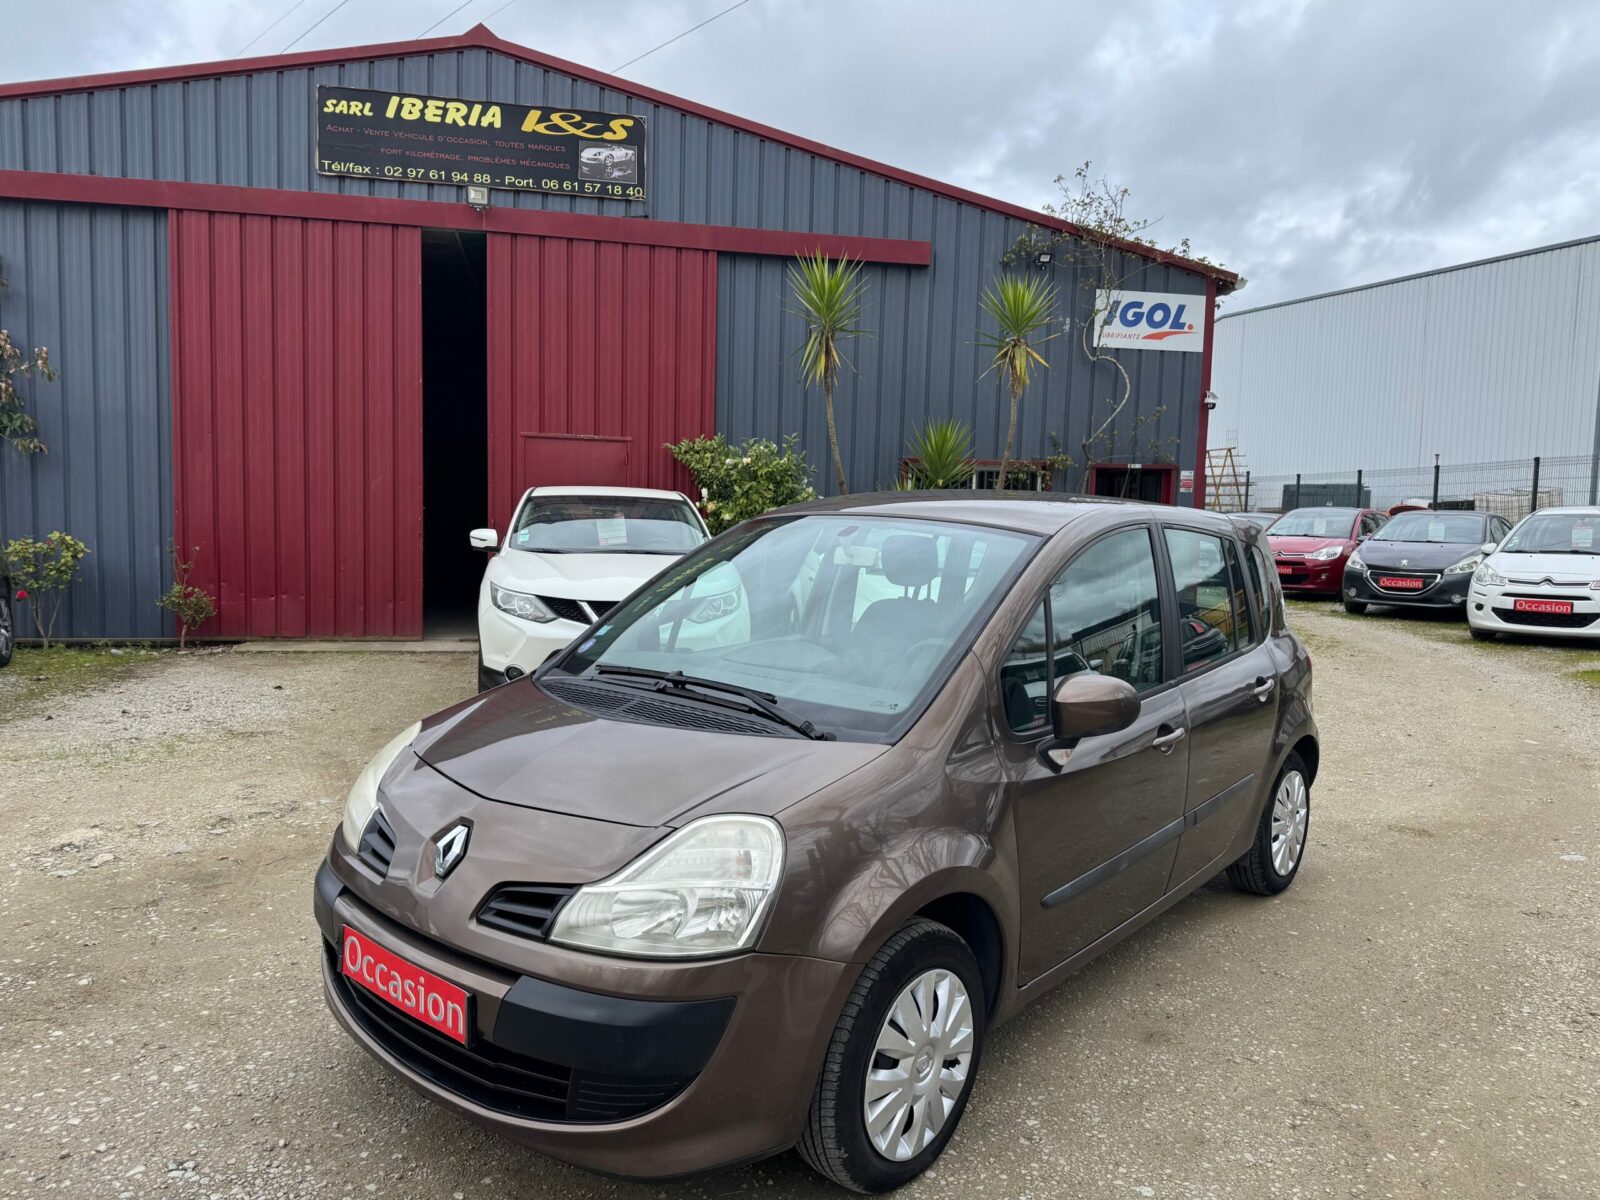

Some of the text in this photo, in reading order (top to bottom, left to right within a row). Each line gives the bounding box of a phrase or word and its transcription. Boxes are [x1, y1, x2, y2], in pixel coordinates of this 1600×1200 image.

[323, 99, 374, 117] SARL
[385, 96, 502, 129] IBERIA
[326, 124, 354, 133] ACHAT
[363, 128, 390, 137] VENTE
[494, 140, 525, 149] TOUTES
[527, 143, 566, 152] MARQUES
[381, 148, 402, 156] FORT
[384, 165, 402, 177] 02
[407, 167, 425, 178] 97
[429, 169, 445, 180] 61
[451, 171, 469, 182] 94
[473, 173, 491, 184] 88
[505, 175, 536, 188] Port.
[541, 179, 559, 190] 06
[563, 181, 579, 192] 61
[584, 183, 601, 193] 57
[606, 185, 622, 195] 18
[626, 186, 643, 197] 40
[1380, 577, 1422, 588] Occasion
[1515, 600, 1571, 613] Occasion
[344, 936, 464, 1035] Occasion
